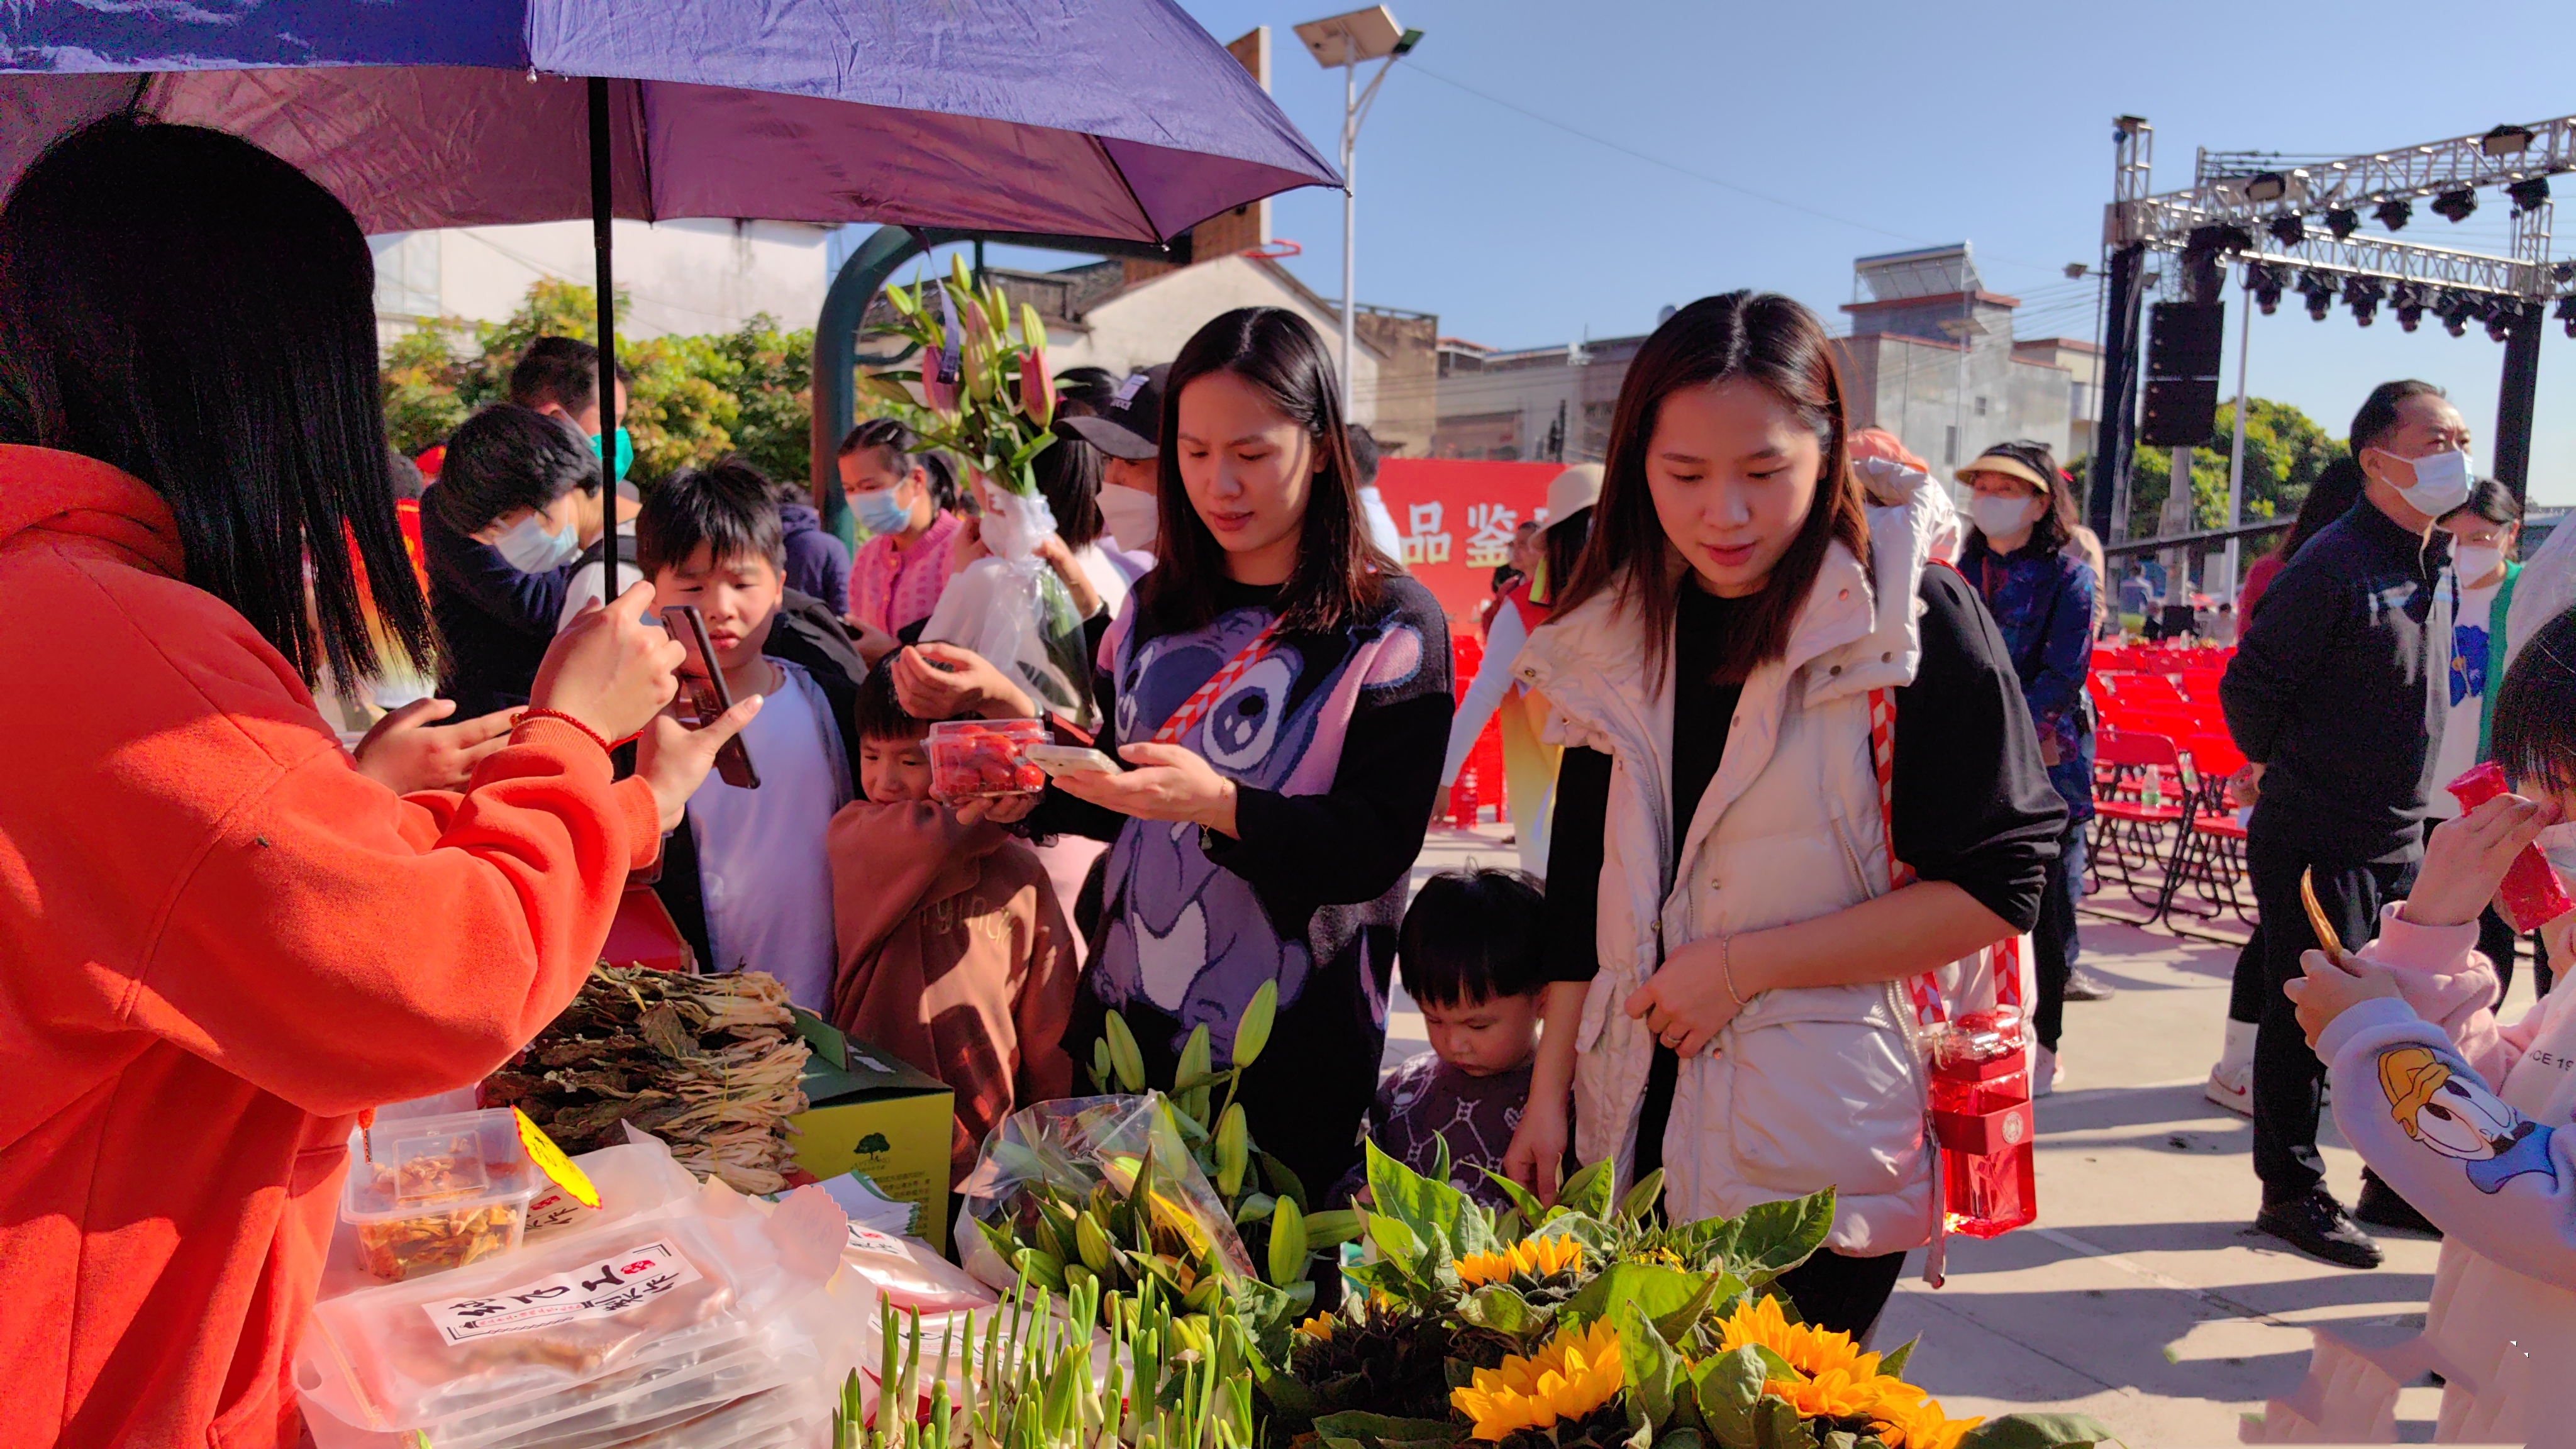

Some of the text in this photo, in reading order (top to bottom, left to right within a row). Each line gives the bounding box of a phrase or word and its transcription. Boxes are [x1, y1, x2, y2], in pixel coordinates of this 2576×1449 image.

[1400, 500, 1550, 569] 品鉴
[2527, 1050, 2552, 1065] CE
[447, 1264, 626, 1318] 纯手工
